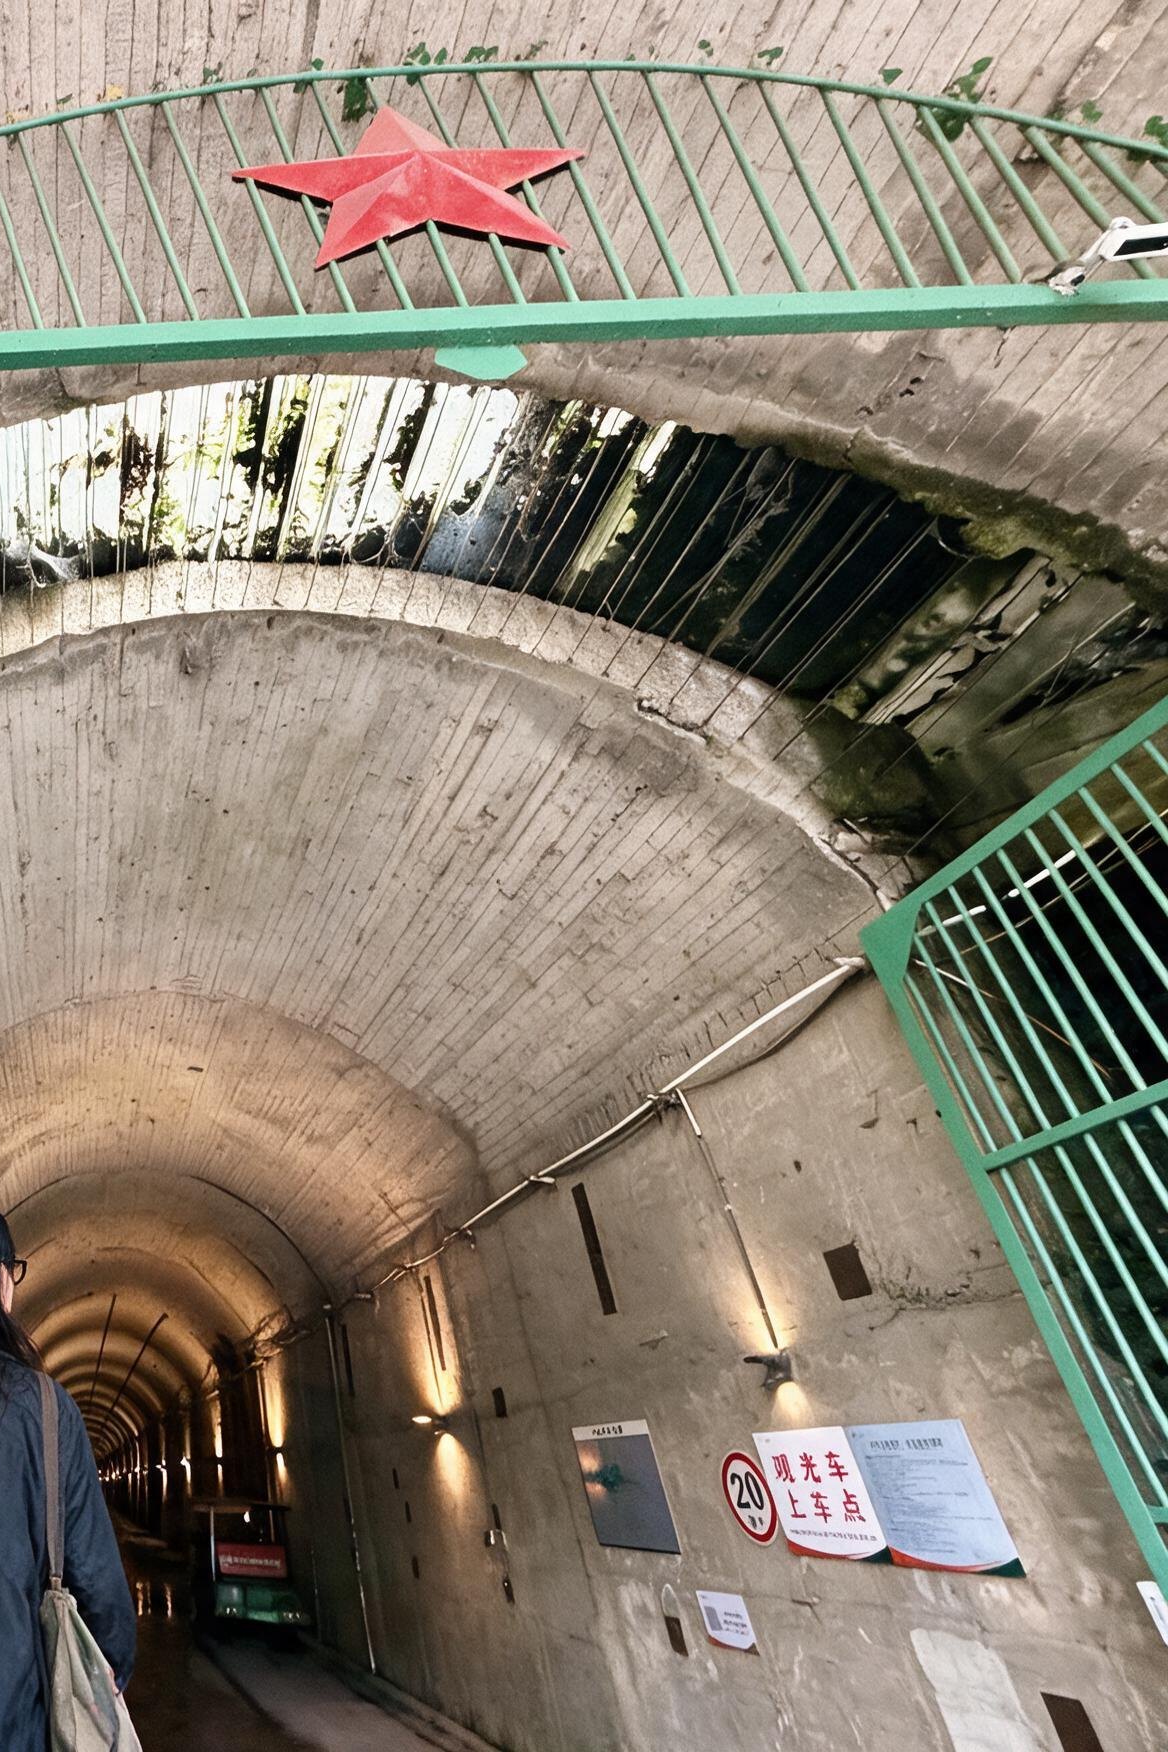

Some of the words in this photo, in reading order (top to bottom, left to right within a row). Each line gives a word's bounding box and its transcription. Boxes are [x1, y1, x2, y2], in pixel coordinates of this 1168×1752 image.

[772, 1451, 848, 1483] 观光车
[730, 1471, 764, 1510] 20
[788, 1488, 866, 1524] 上车点
